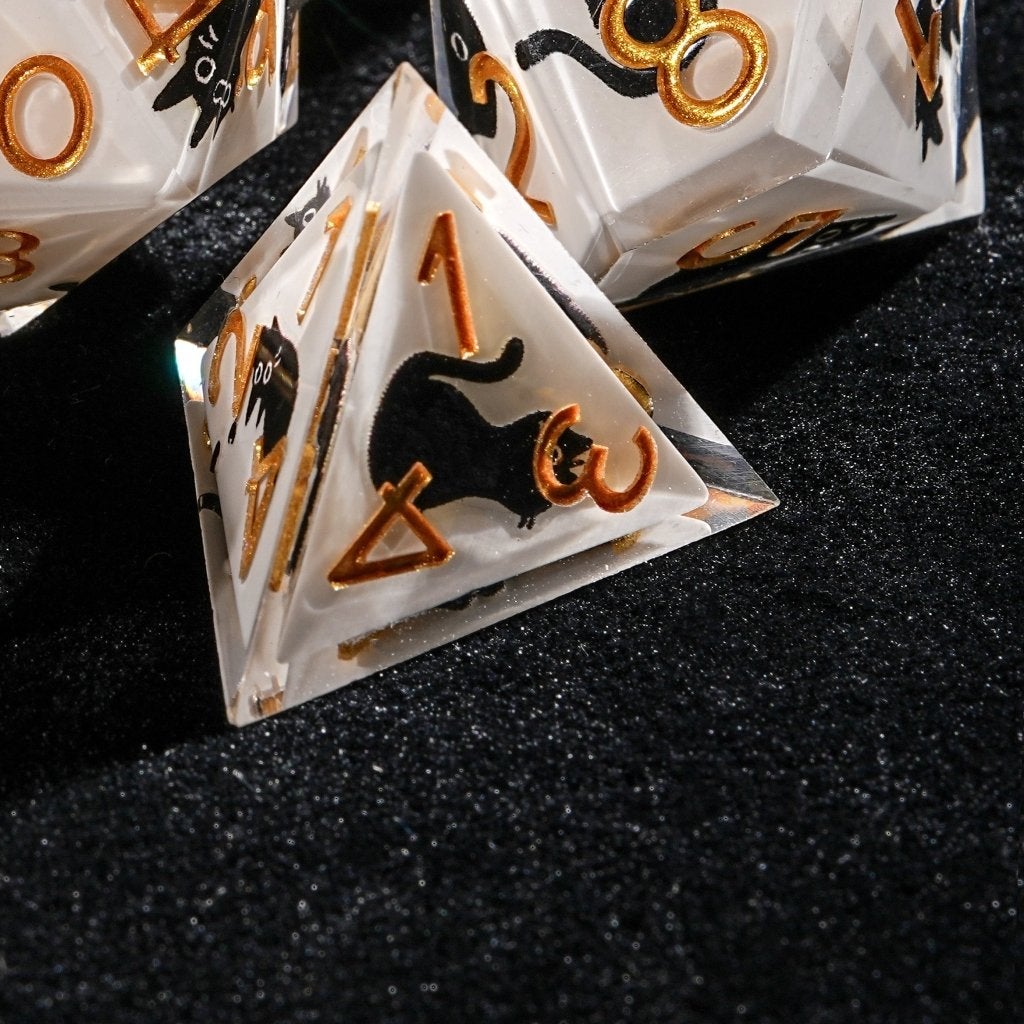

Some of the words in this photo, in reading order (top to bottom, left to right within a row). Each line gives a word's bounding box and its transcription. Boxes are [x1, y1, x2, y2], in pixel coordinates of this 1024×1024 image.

[416, 209, 480, 360] 1
[532, 402, 658, 514] 3
[327, 461, 456, 592] 4
